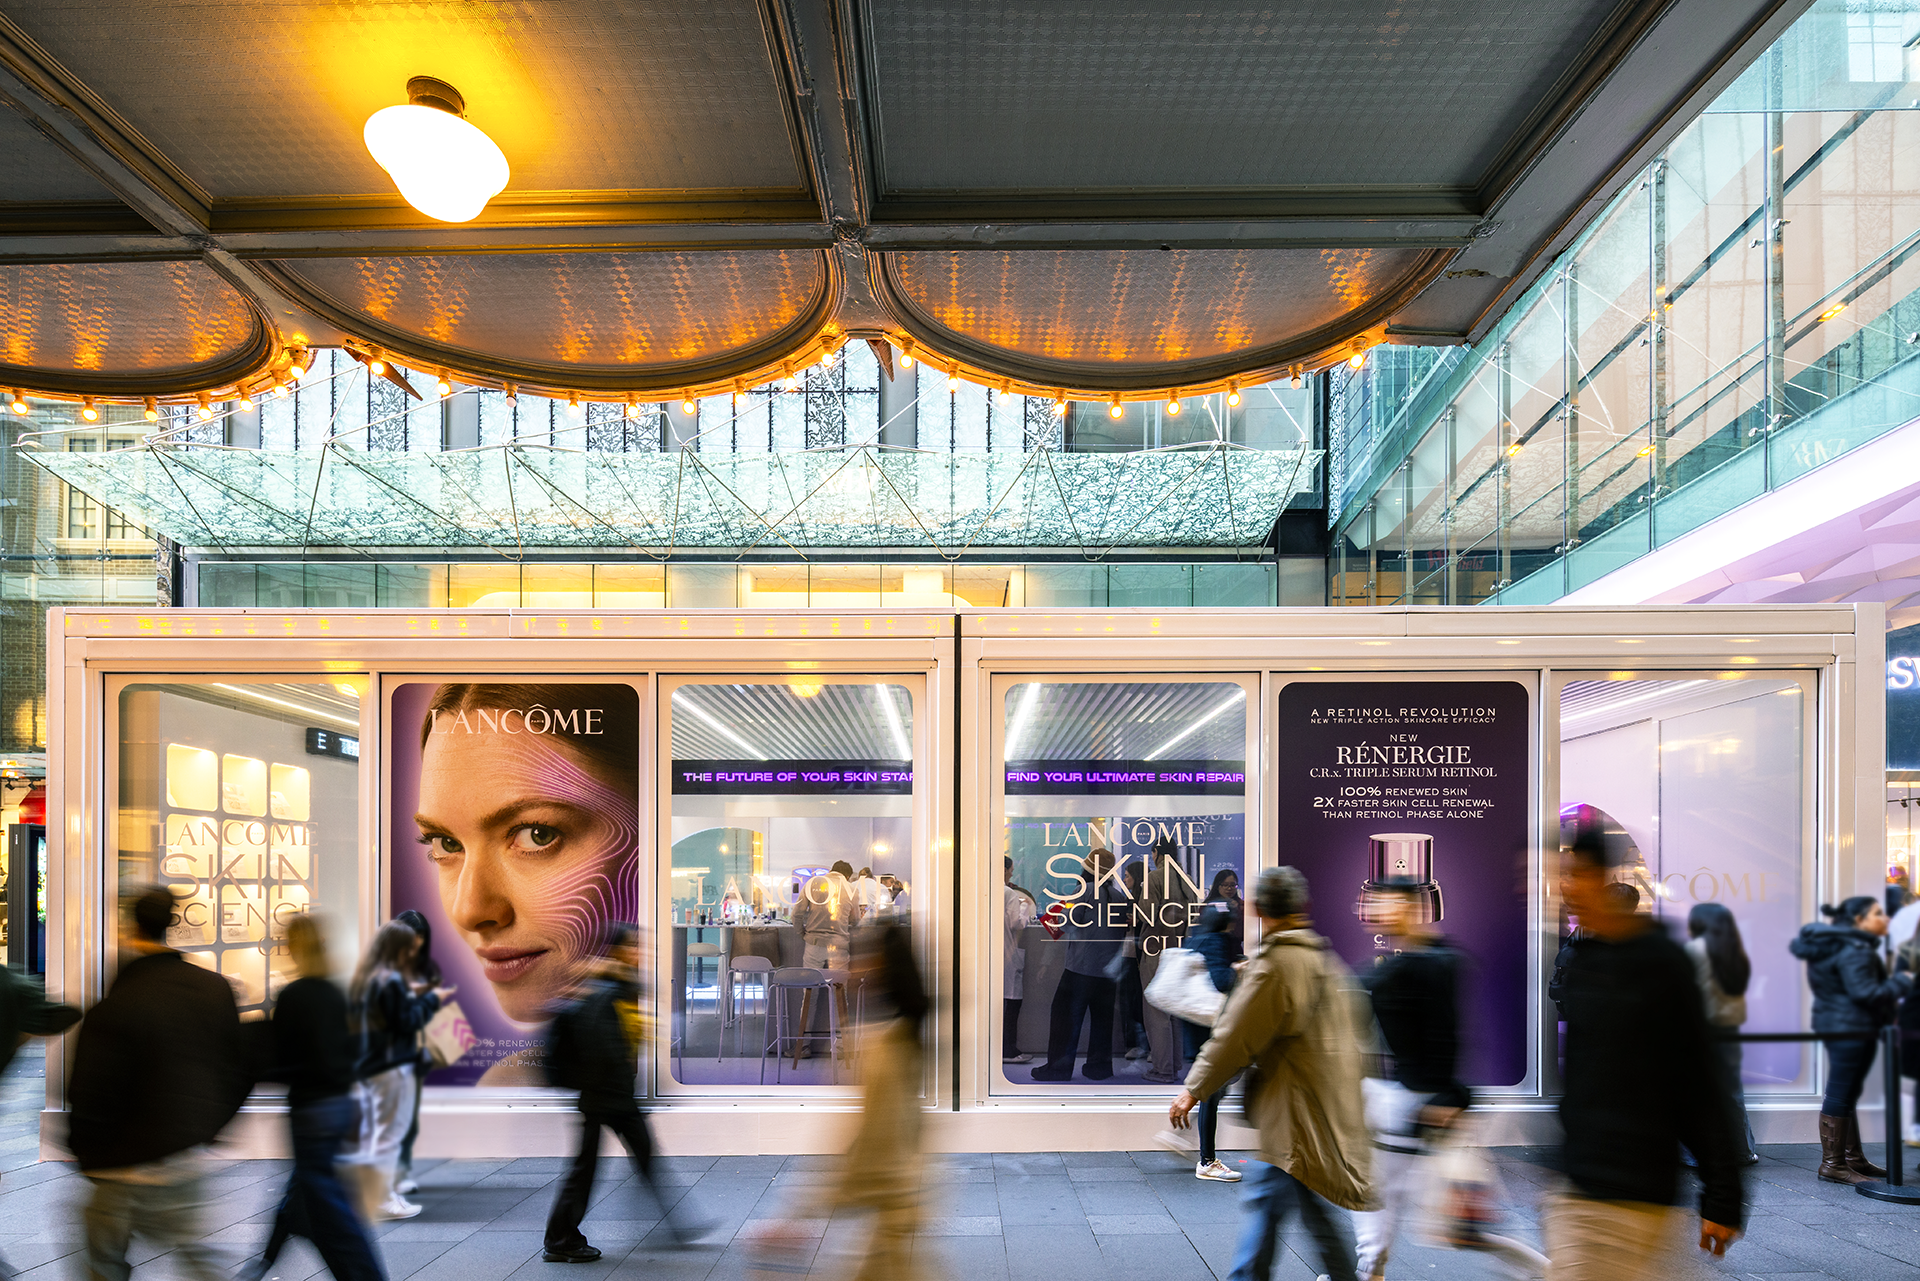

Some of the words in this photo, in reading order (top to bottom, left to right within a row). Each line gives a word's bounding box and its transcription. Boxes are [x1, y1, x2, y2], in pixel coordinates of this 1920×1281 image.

[1310, 708, 1320, 717] A
[1327, 708, 1392, 717] RETINOL
[1400, 707, 1496, 717] REVOLUTION
[430, 703, 604, 735] LANCÔME
[1389, 733, 1419, 743] NEW
[1336, 741, 1472, 765] RÉNERGIE
[683, 772, 713, 783] THE
[716, 772, 773, 783] FUTURE
[776, 772, 798, 783] OF
[801, 772, 840, 783] YOUR
[843, 772, 878, 783] SKIN
[1006, 772, 1041, 783] FIND
[1044, 772, 1083, 783] YOUR
[1086, 772, 1156, 783] ULTIMATE
[1159, 772, 1193, 783] SKIN
[1196, 772, 1245, 783] REPAIR
[1344, 767, 1390, 778] TRIPLE
[1392, 767, 1438, 778] SERUM
[1441, 767, 1498, 778] RETINOL
[1340, 786, 1382, 796] 100%
[1385, 788, 1440, 796] RENEWED
[1313, 796, 1335, 808] 2X
[1337, 799, 1379, 808] FASTER
[1382, 799, 1408, 808] SKIN
[1411, 799, 1439, 808] CELL
[1442, 799, 1495, 808] RENEWAL
[1322, 810, 1352, 819] THAN
[1356, 810, 1403, 819] RETINOL
[1406, 810, 1444, 819] PHASE
[158, 817, 319, 847] LANCÔME
[1043, 817, 1206, 847] LANCÔME
[160, 853, 319, 900] SKIN
[1042, 853, 1205, 900] SKIN
[695, 868, 897, 905] LANCÔME
[1612, 866, 1780, 903] NCÔME
[498, 1039, 546, 1048] RENEWED
[496, 1049, 518, 1057] SKIN
[521, 1049, 546, 1057] CELL
[473, 1059, 514, 1067] RETINOL
